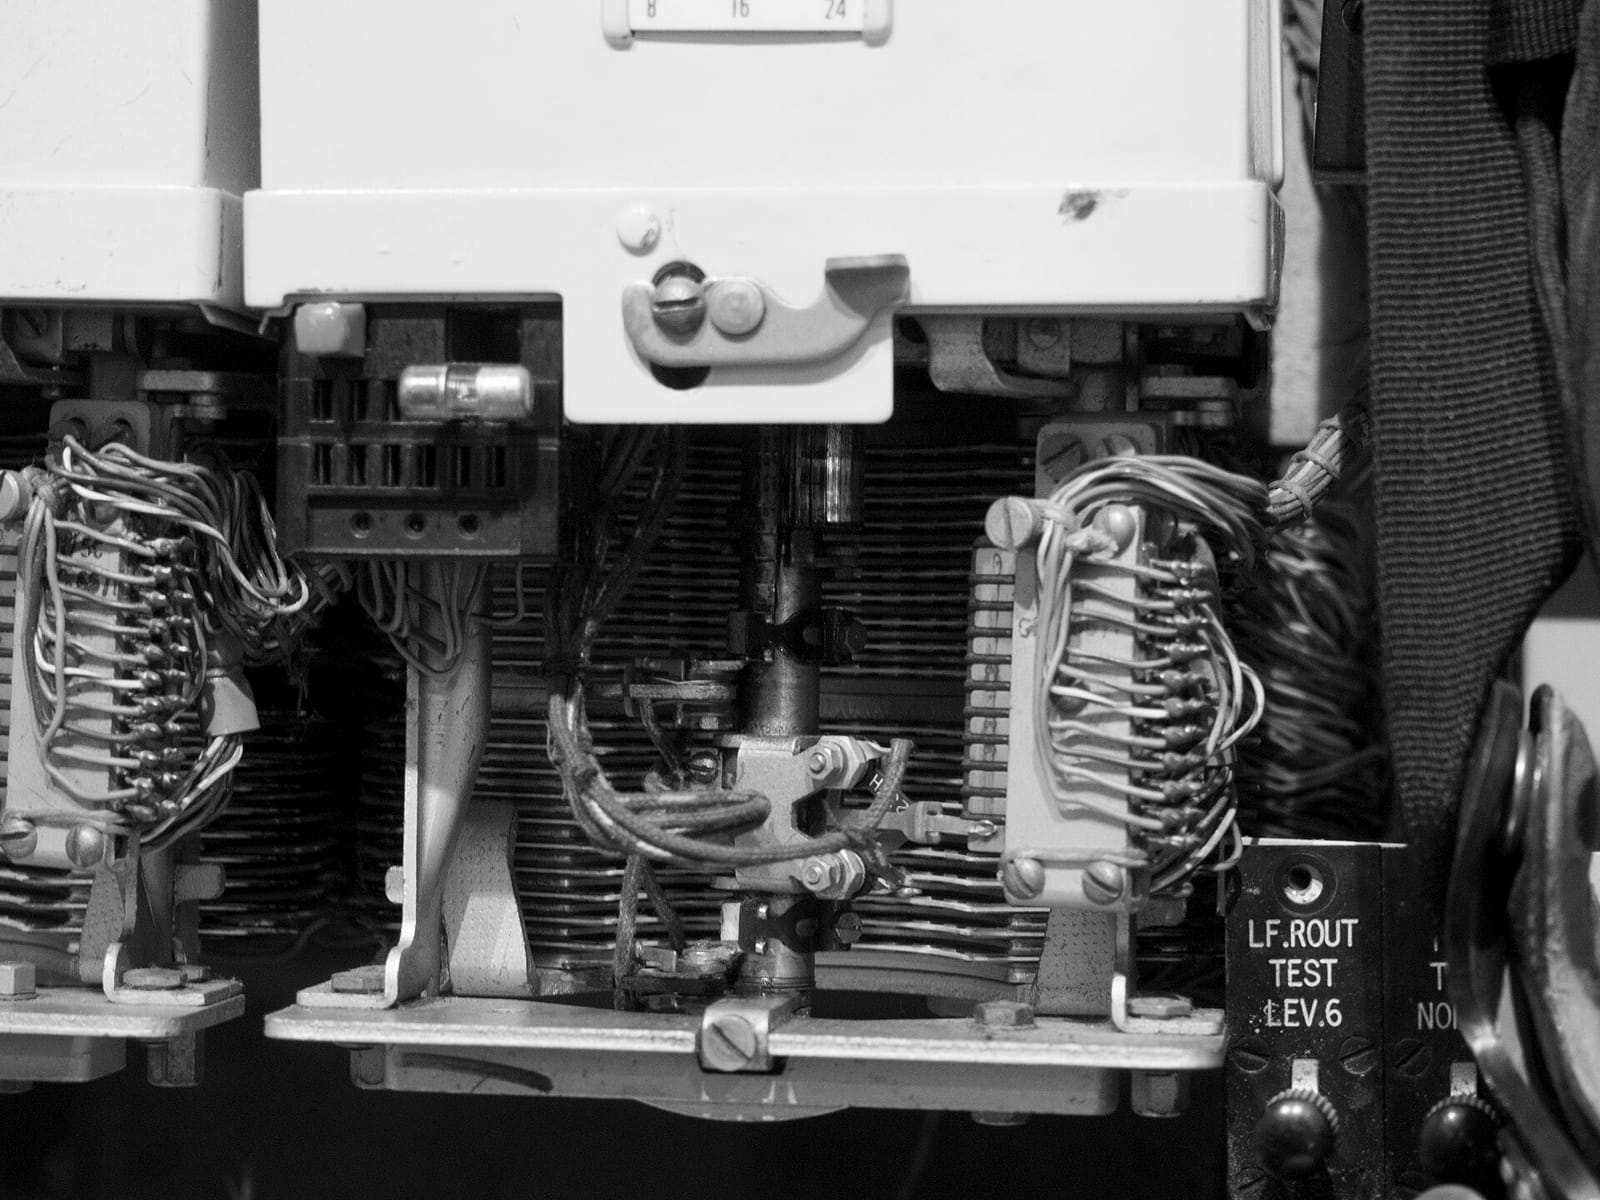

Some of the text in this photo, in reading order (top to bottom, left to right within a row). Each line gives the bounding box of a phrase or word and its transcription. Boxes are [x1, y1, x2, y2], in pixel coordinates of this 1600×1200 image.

[647, 0, 846, 20] 8 16 24
[1248, 918, 1359, 948] LF.ROUT
[1268, 958, 1338, 987] TEST
[1265, 998, 1342, 1028] LEV.6
